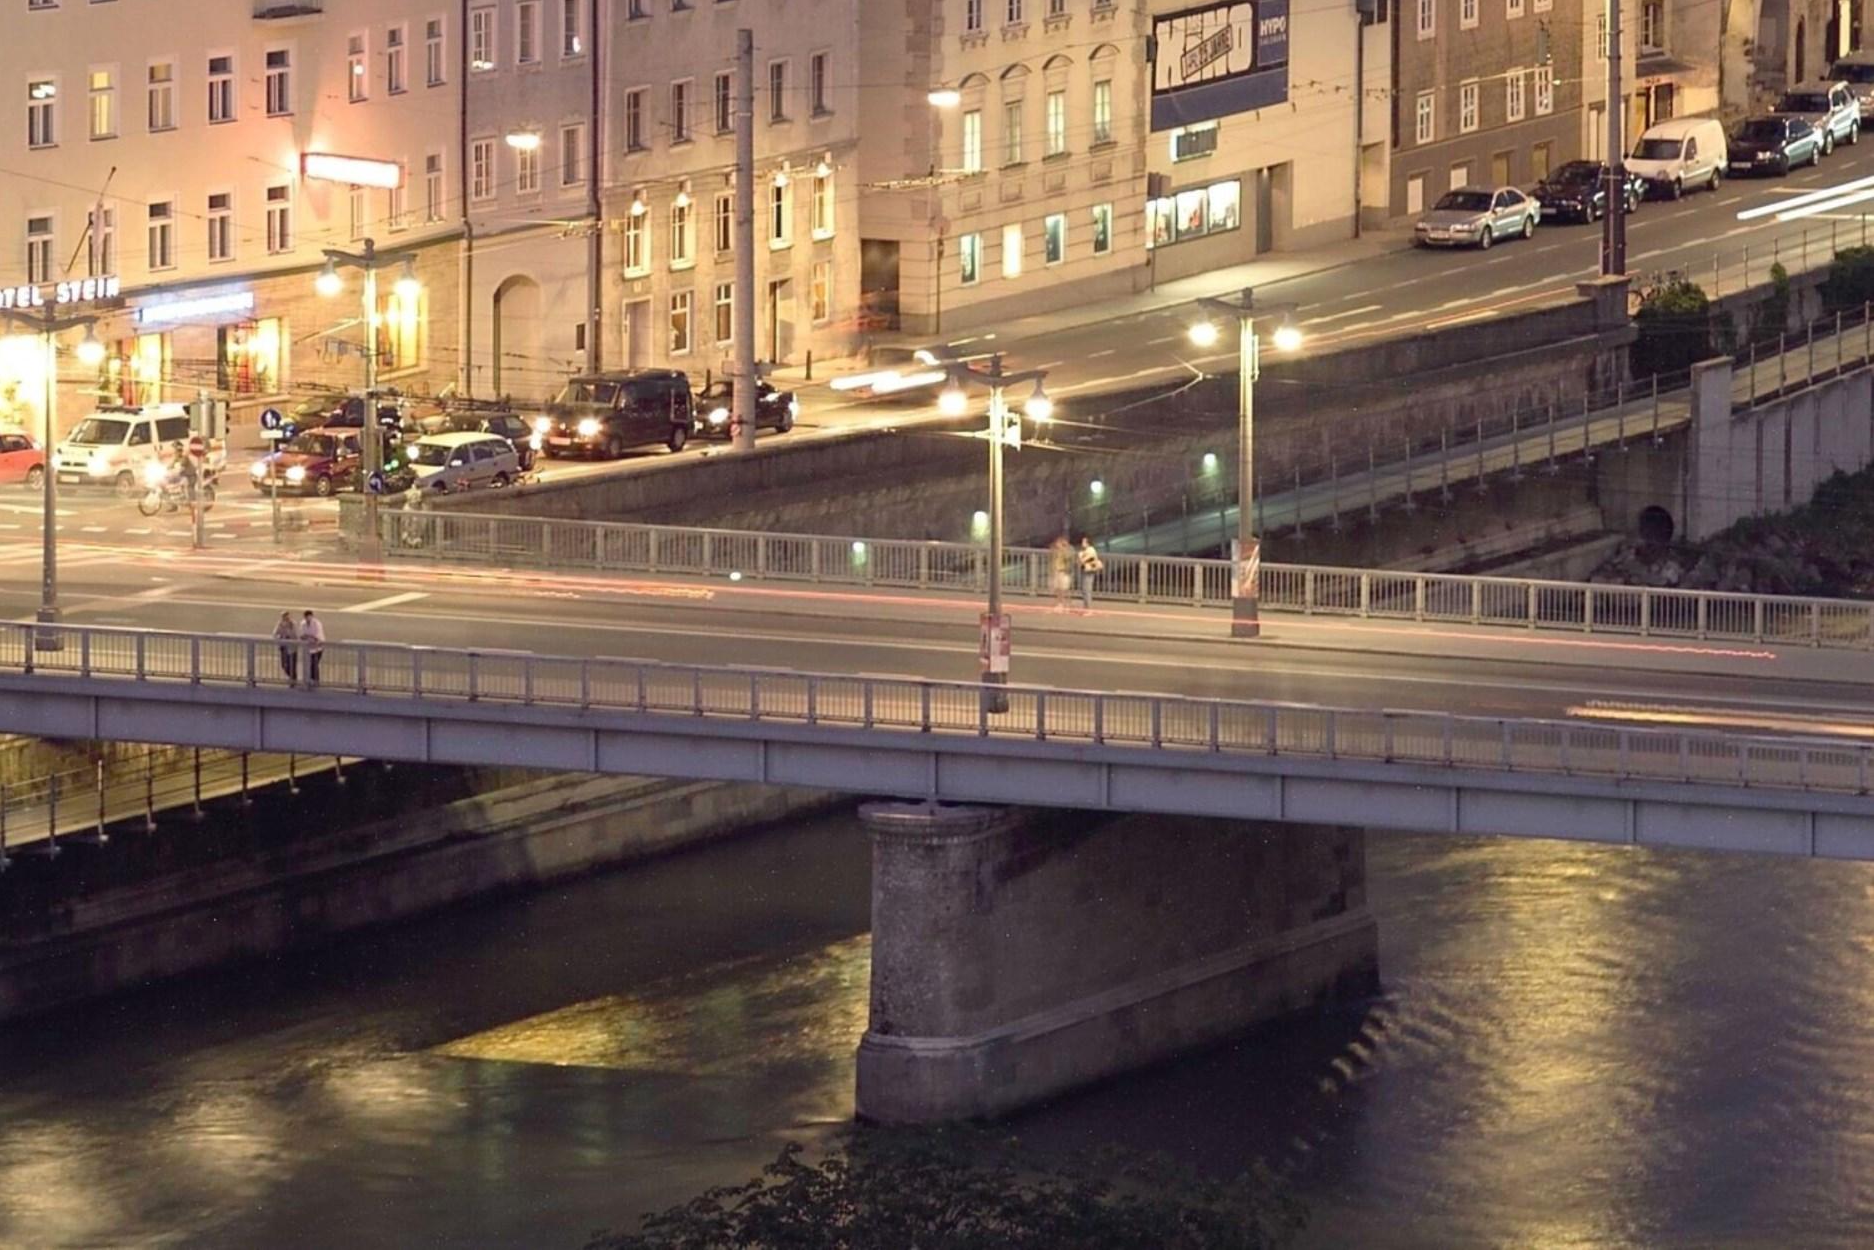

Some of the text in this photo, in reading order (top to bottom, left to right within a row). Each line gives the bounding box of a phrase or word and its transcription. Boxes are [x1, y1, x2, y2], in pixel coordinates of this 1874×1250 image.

[1260, 16, 1286, 36] HYPO
[1156, 3, 1253, 90] KINO
[56, 277, 120, 304] STEIN
